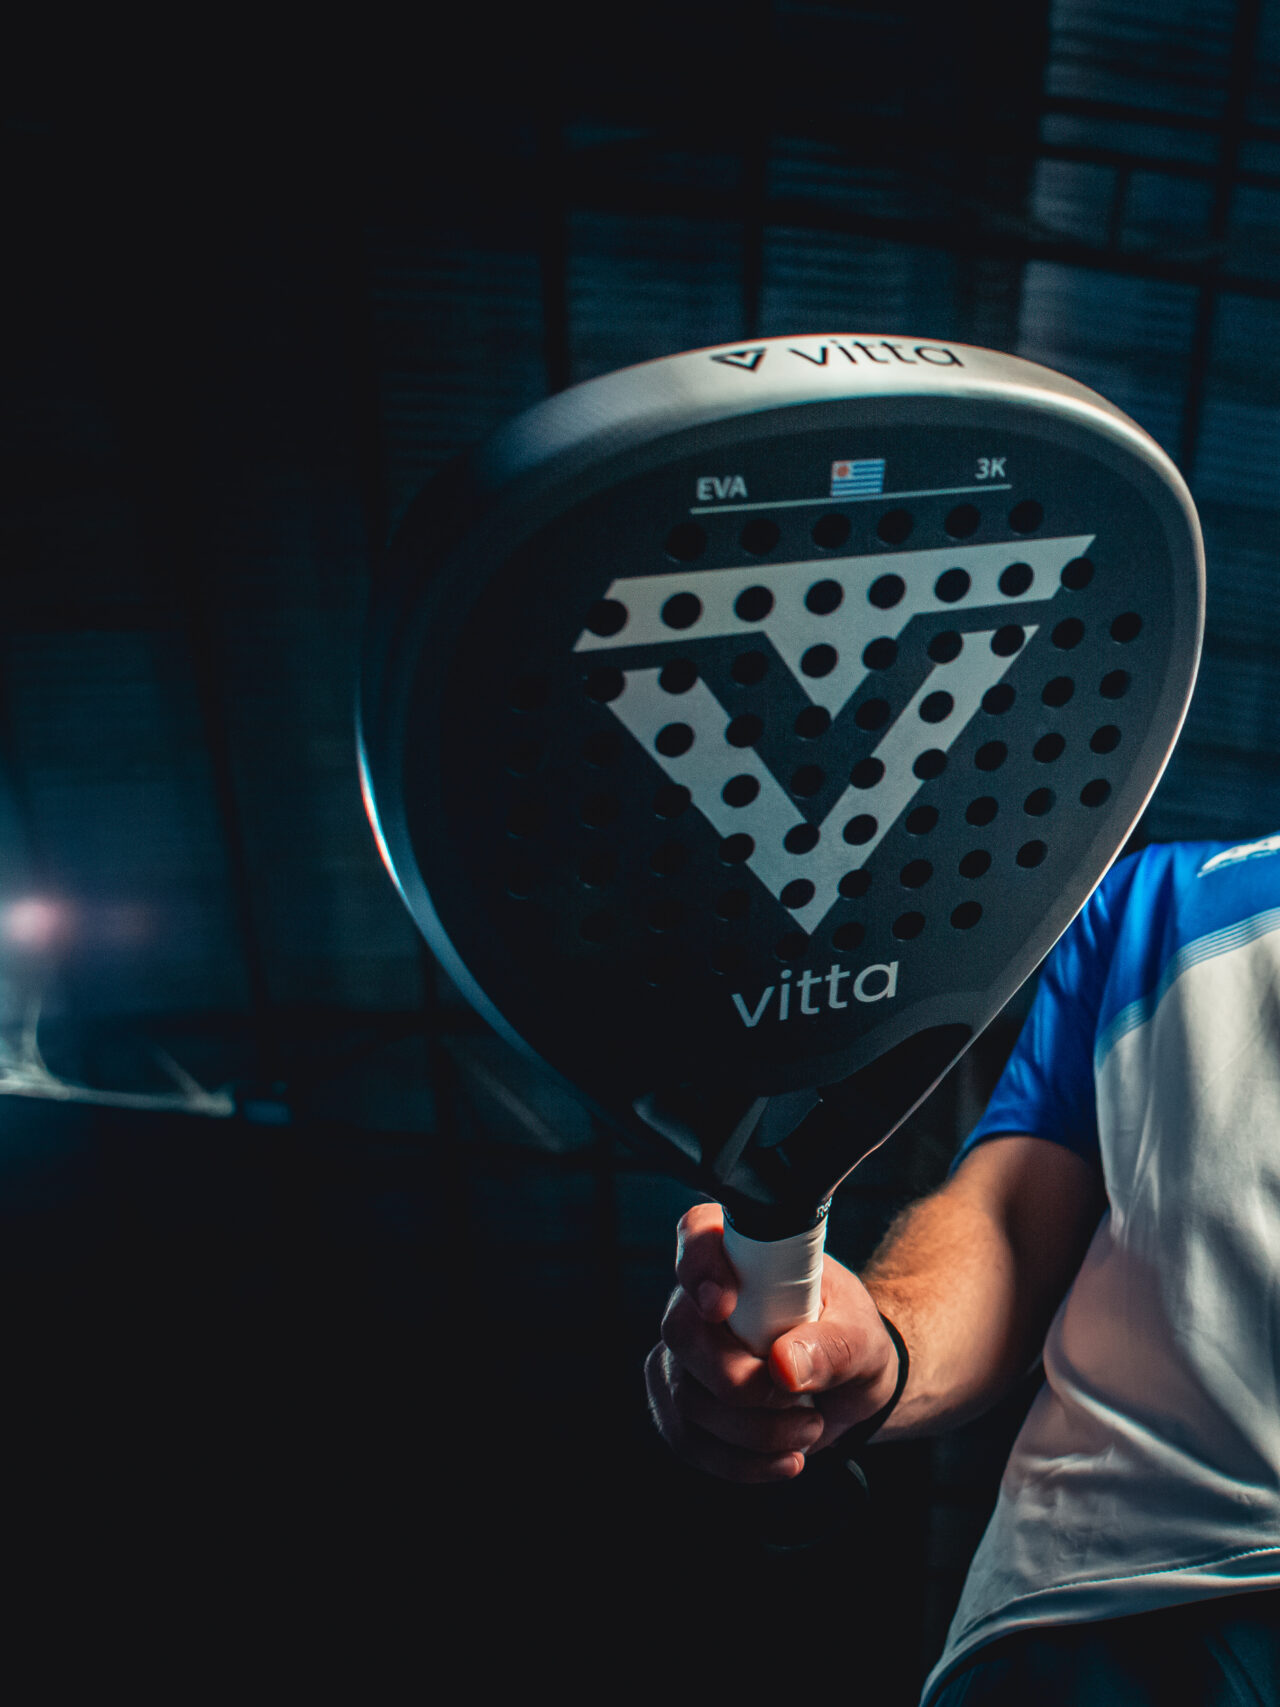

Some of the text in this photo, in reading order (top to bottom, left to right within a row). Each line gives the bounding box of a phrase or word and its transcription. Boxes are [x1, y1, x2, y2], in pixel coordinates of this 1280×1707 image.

[789, 339, 965, 368] vitta
[696, 456, 1007, 501] EVA 3K
[731, 960, 899, 1028] vitta
